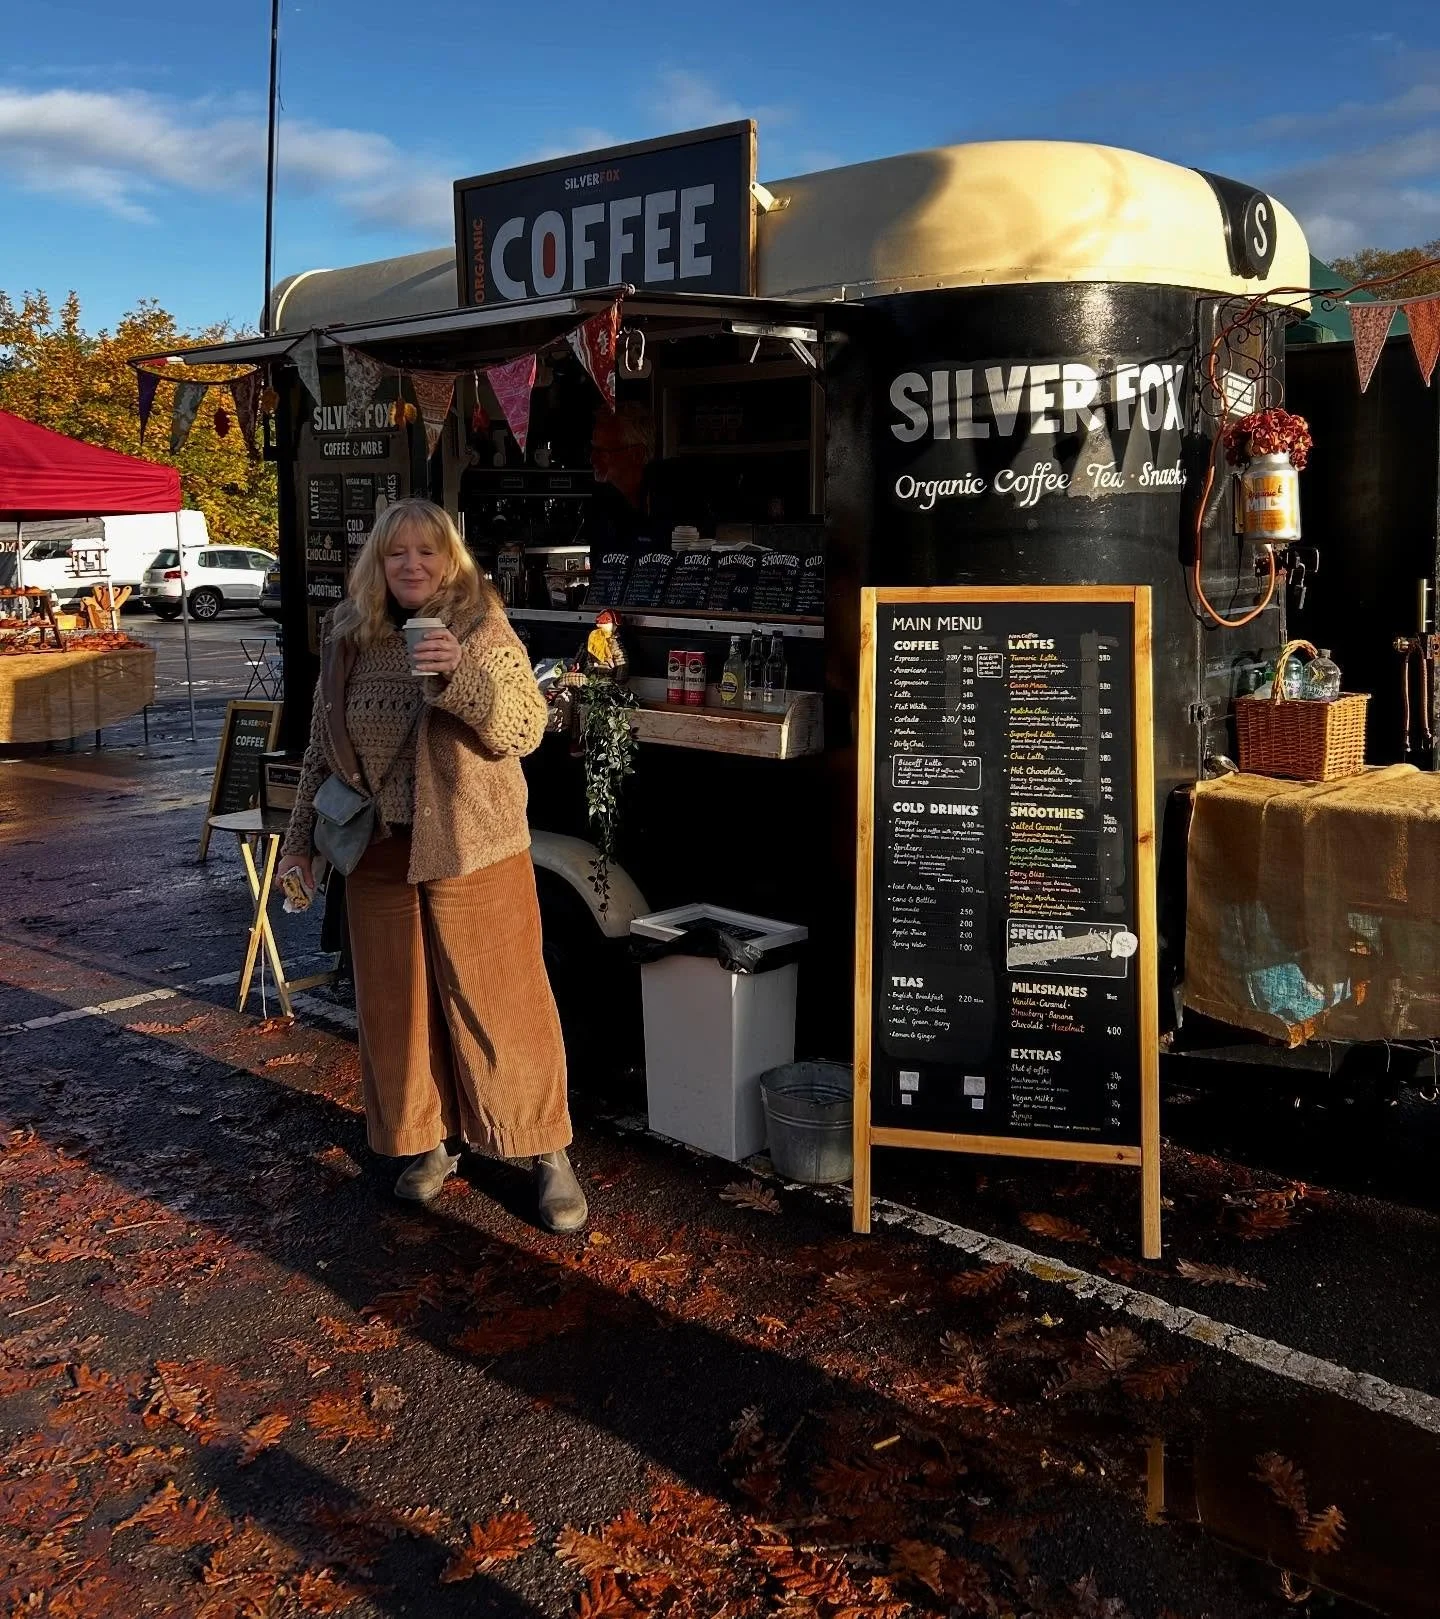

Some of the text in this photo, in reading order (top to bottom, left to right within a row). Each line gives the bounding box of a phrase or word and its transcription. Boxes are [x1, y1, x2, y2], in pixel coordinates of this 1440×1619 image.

[1253, 202, 1268, 257] S
[490, 184, 715, 301] COFFEE
[473, 217, 486, 304] ORGANIC
[890, 364, 1105, 443] SILVER
[1116, 363, 1185, 432] FOX
[323, 442, 350, 457] COFFEE
[360, 440, 383, 456] MORE
[895, 472, 987, 510] Organic
[994, 462, 1072, 508] Coffee
[1086, 460, 1125, 489] Tea
[311, 479, 320, 520] LATTES
[347, 519, 364, 532] COLD
[306, 549, 342, 562] CHOCOLATE
[602, 553, 629, 566] COFFEE
[652, 553, 674, 566] COFFEE
[718, 553, 757, 568] MILKSHAKES
[761, 554, 799, 568] SMOOTHIES
[308, 583, 342, 598] SMOOTHIES
[891, 616, 982, 631] MAIN MENU
[894, 640, 940, 651] COFFEE
[1008, 638, 1055, 650] LATTES
[1039, 653, 1059, 661] Latte
[894, 701, 909, 710] Flat
[909, 702, 928, 710] White
[1009, 730, 1039, 739] Superfood
[1039, 730, 1056, 738] Latte
[235, 735, 265, 748] COFFEE
[909, 740, 925, 748] Chai
[897, 758, 923, 767] Biscoff
[1010, 752, 1026, 760] Chai
[1026, 752, 1045, 761] Latte
[1010, 766, 1066, 776] Hot Chocolate
[892, 801, 979, 816] COLD DRINKS
[1010, 806, 1084, 820] SMOOTHIES
[1010, 822, 1034, 831] Salted
[1035, 822, 1063, 831] Caramel
[1028, 846, 1055, 855] Goddess
[1009, 869, 1045, 879] Berry Bliss
[915, 897, 937, 905] Bottles
[1009, 893, 1056, 903] Monkey Mocha
[892, 928, 909, 938] Apple
[910, 928, 927, 936] Juice
[1010, 929, 1066, 940] SPECIAL
[892, 940, 910, 950] Spring
[891, 976, 924, 988] TEAS
[1011, 982, 1088, 998] MILKSHAKES
[892, 992, 913, 1001] English
[915, 992, 944, 1002] Breakfast
[1012, 997, 1067, 1010] Vanilla Caramel
[1010, 1007, 1074, 1021] Strawberry Banana
[933, 1019, 951, 1031] Berry
[1011, 1020, 1044, 1030] Chocolate
[1050, 1022, 1086, 1034] Hazelnut
[916, 1032, 937, 1043] Ginger
[1010, 1048, 1062, 1062] EXTRAS
[1010, 1063, 1025, 1072] Shot
[1012, 1093, 1033, 1104] Vegan
[1034, 1095, 1054, 1103] Milks
[1011, 1110, 1033, 1122] Syrups
